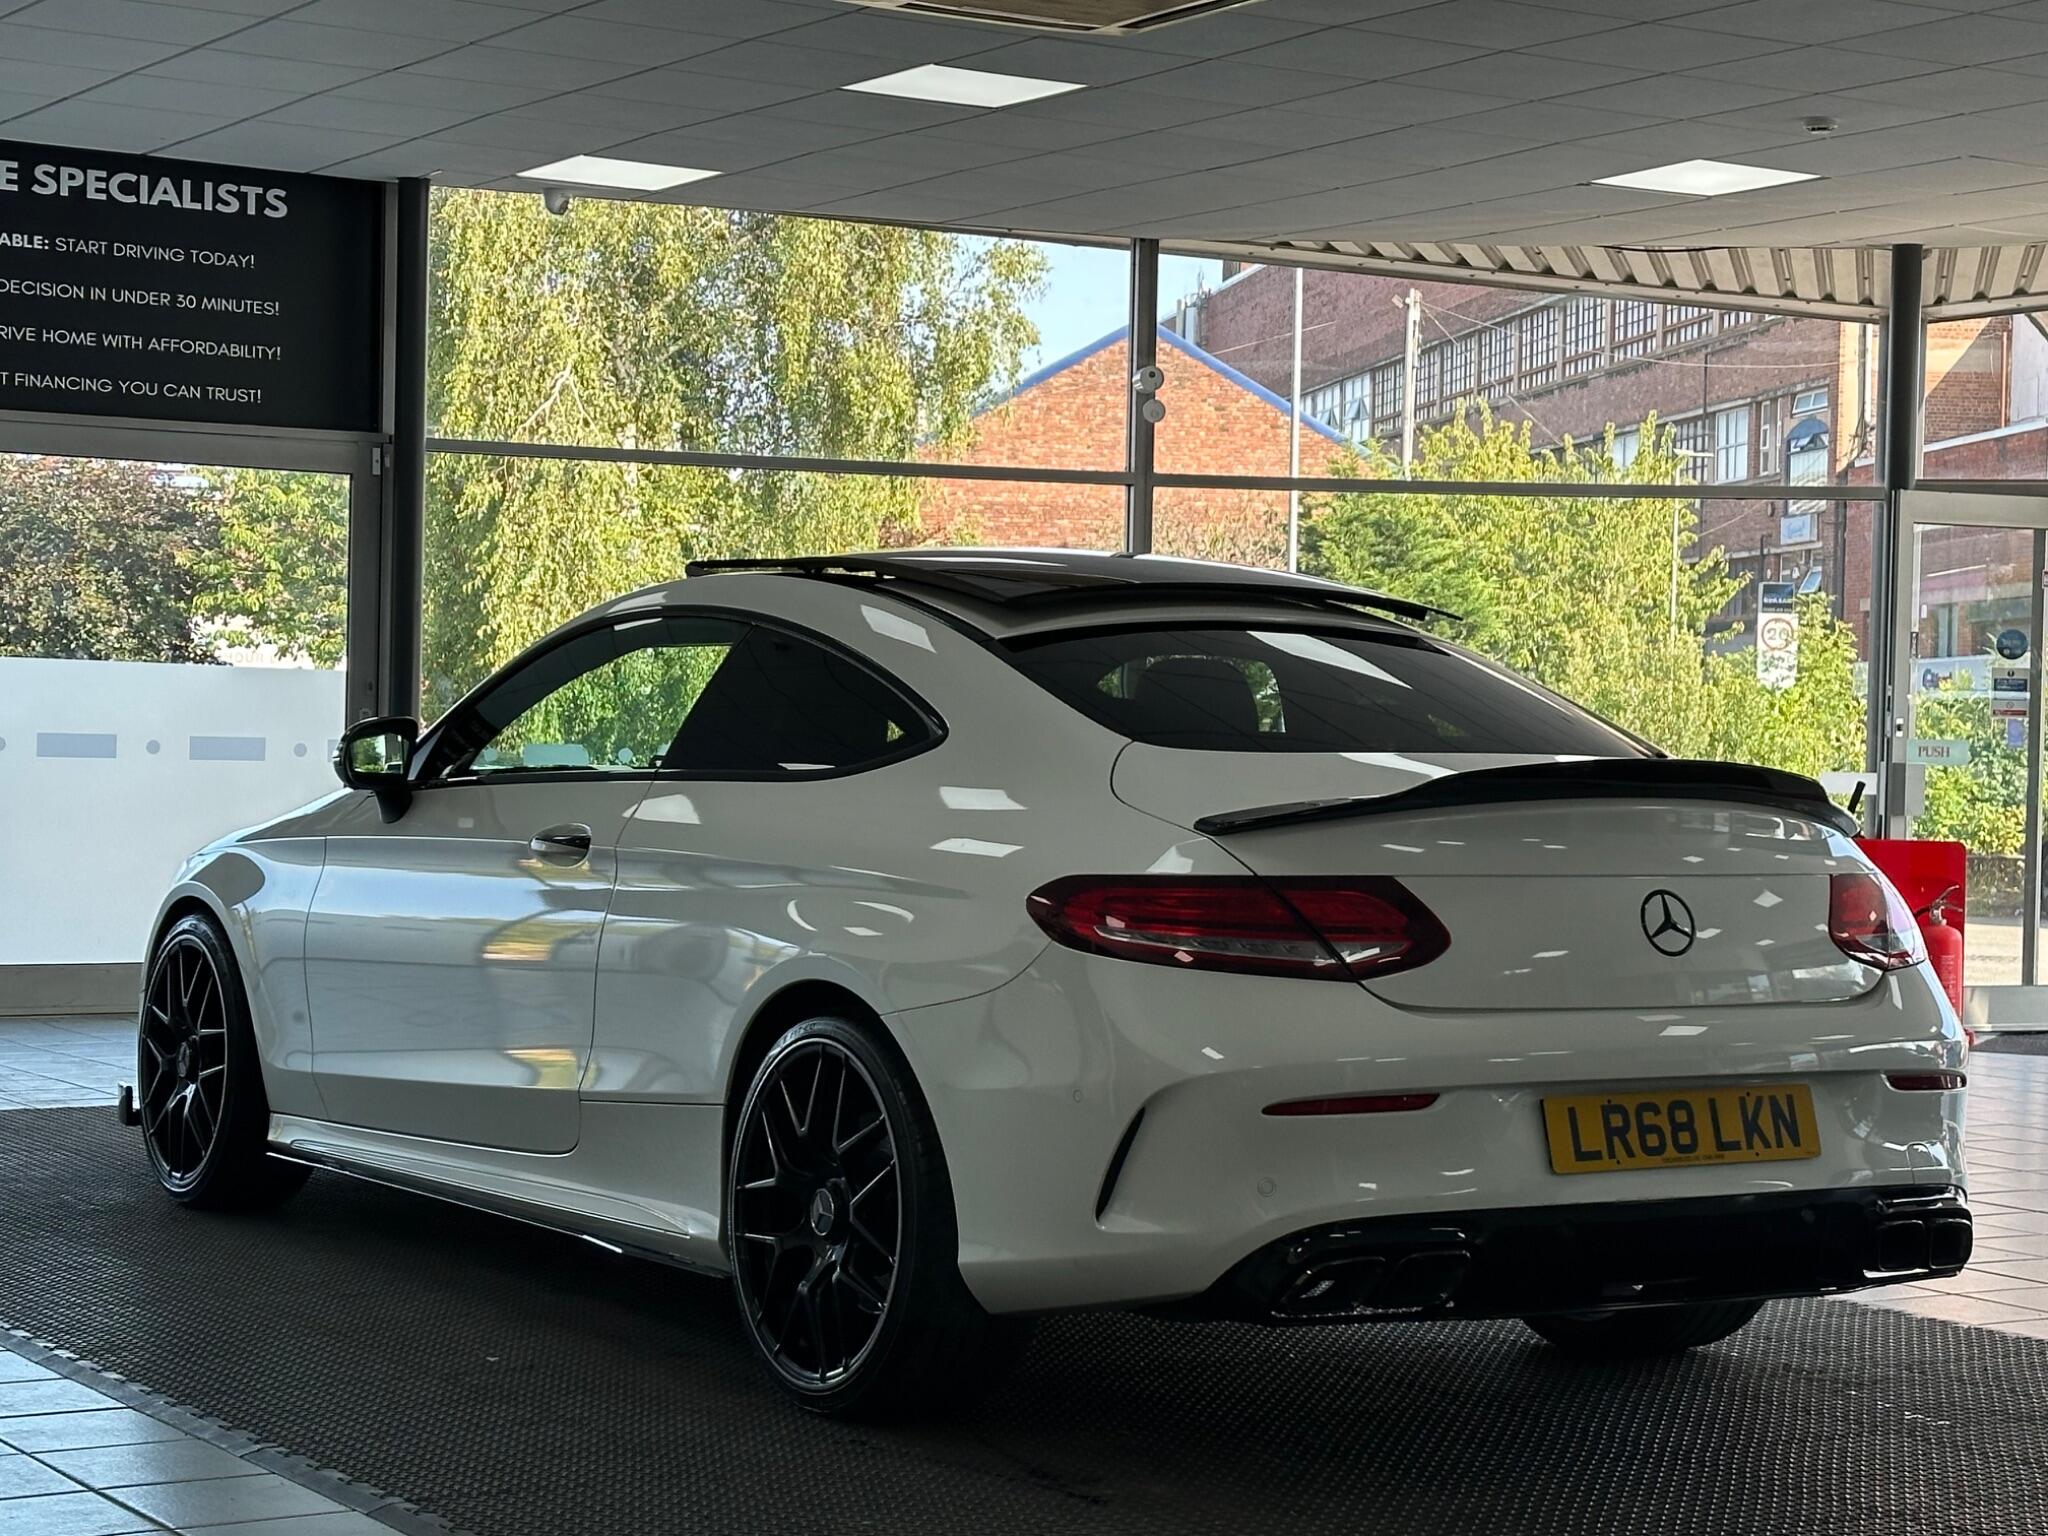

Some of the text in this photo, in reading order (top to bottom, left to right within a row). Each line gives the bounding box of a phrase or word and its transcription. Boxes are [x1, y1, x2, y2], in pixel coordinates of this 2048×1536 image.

[31, 163, 289, 218] SPECIALISTS
[0, 232, 255, 269] ABLE: START DRIVING TODAY!
[0, 278, 280, 316] DECISION IN UNDER 30 MINUTES!
[42, 328, 97, 347] HOME
[102, 333, 143, 350] WITH
[148, 337, 281, 361] AFFORDABILITY!
[14, 372, 113, 393] FINANCING
[118, 380, 158, 396] YOU
[163, 383, 201, 400] CAN
[206, 386, 262, 404] TRUST!
[1918, 745, 1950, 758] PUSH
[1567, 1093, 1801, 1162] LR68 LKN
